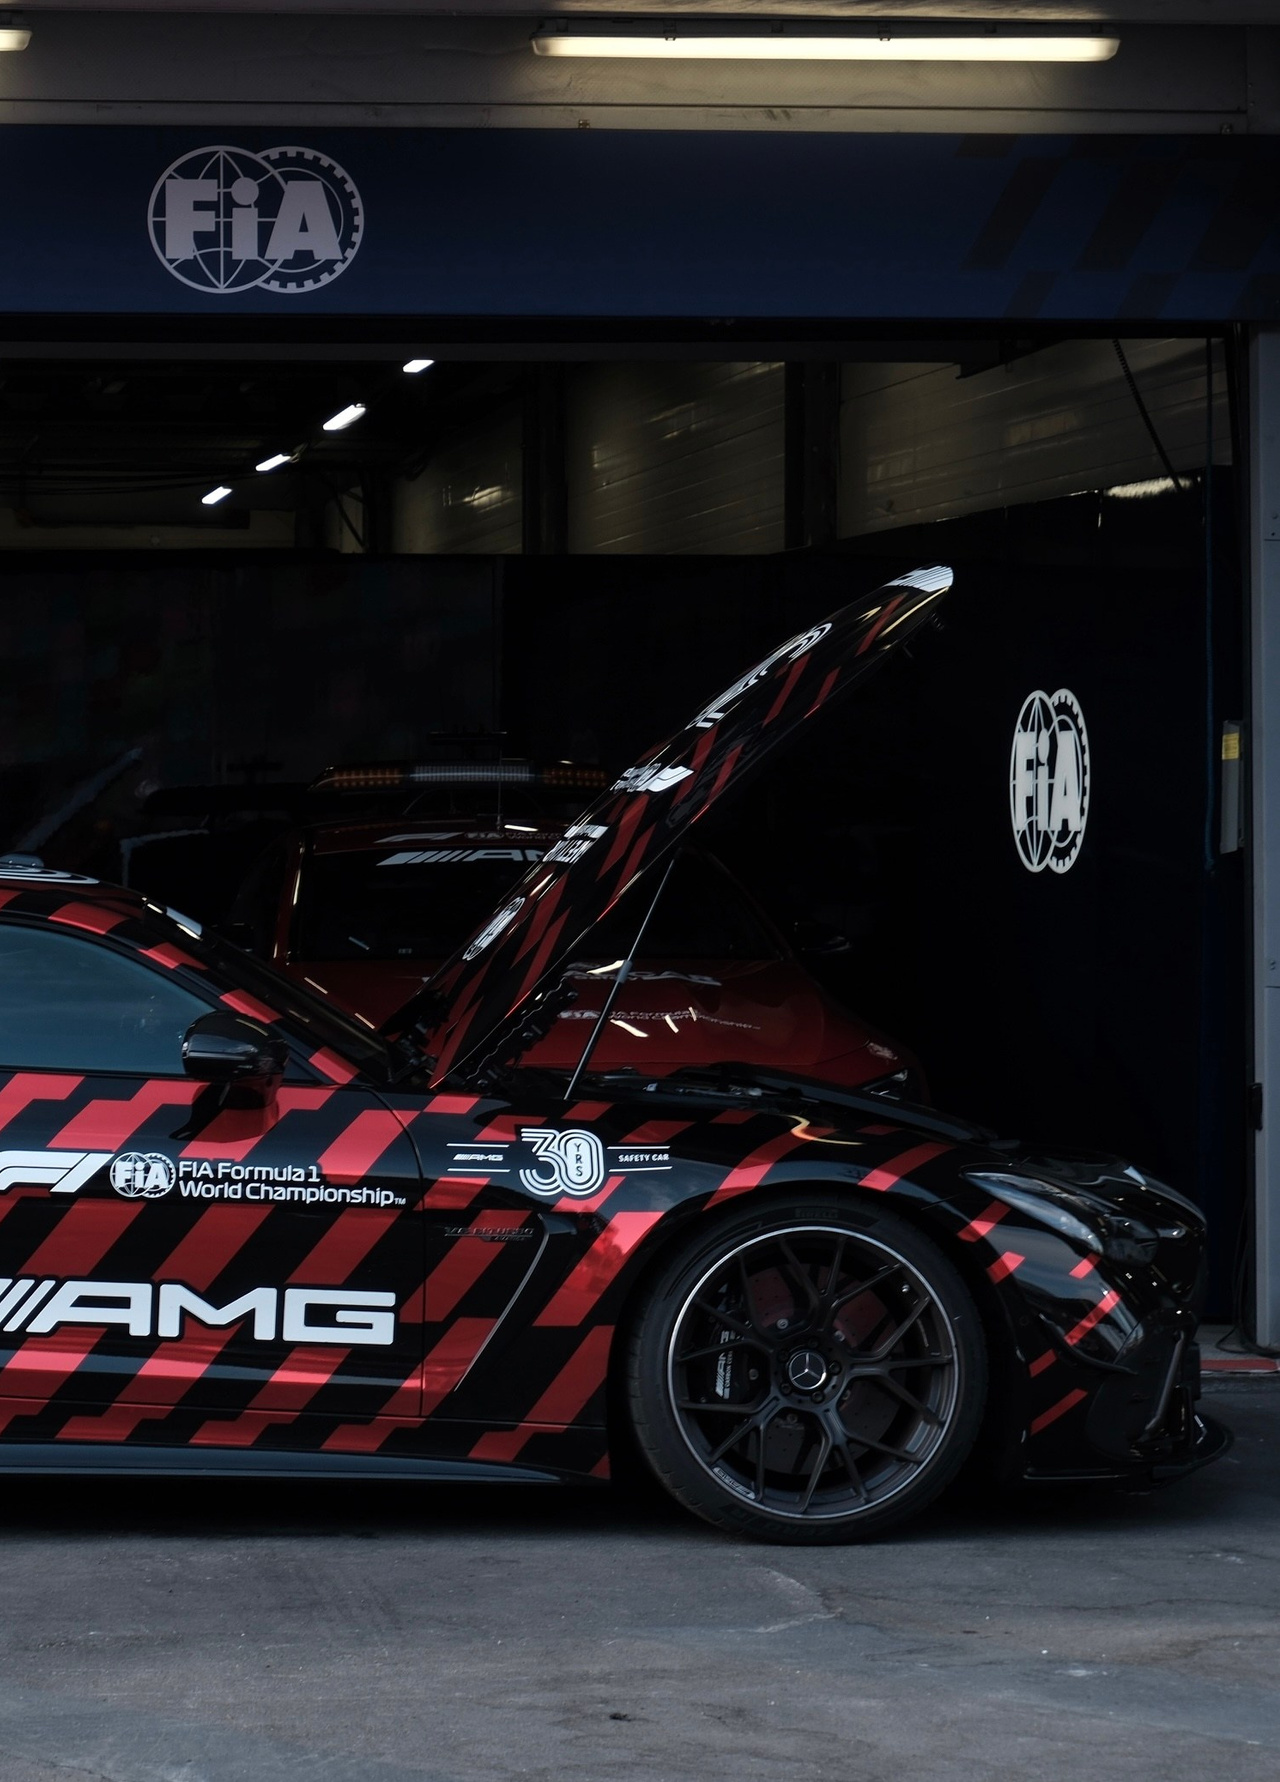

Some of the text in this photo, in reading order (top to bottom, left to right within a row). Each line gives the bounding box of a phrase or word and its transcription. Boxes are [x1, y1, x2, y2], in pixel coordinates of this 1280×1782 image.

[473, 1153, 504, 1162] AMG
[518, 1128, 606, 1196] 30
[618, 1153, 670, 1163] SAFETY CAR
[178, 1161, 214, 1178] FIA
[218, 1162, 304, 1182] Formula
[308, 1166, 321, 1183] 1
[178, 1182, 242, 1200] World
[26, 1279, 397, 1347] AMG
